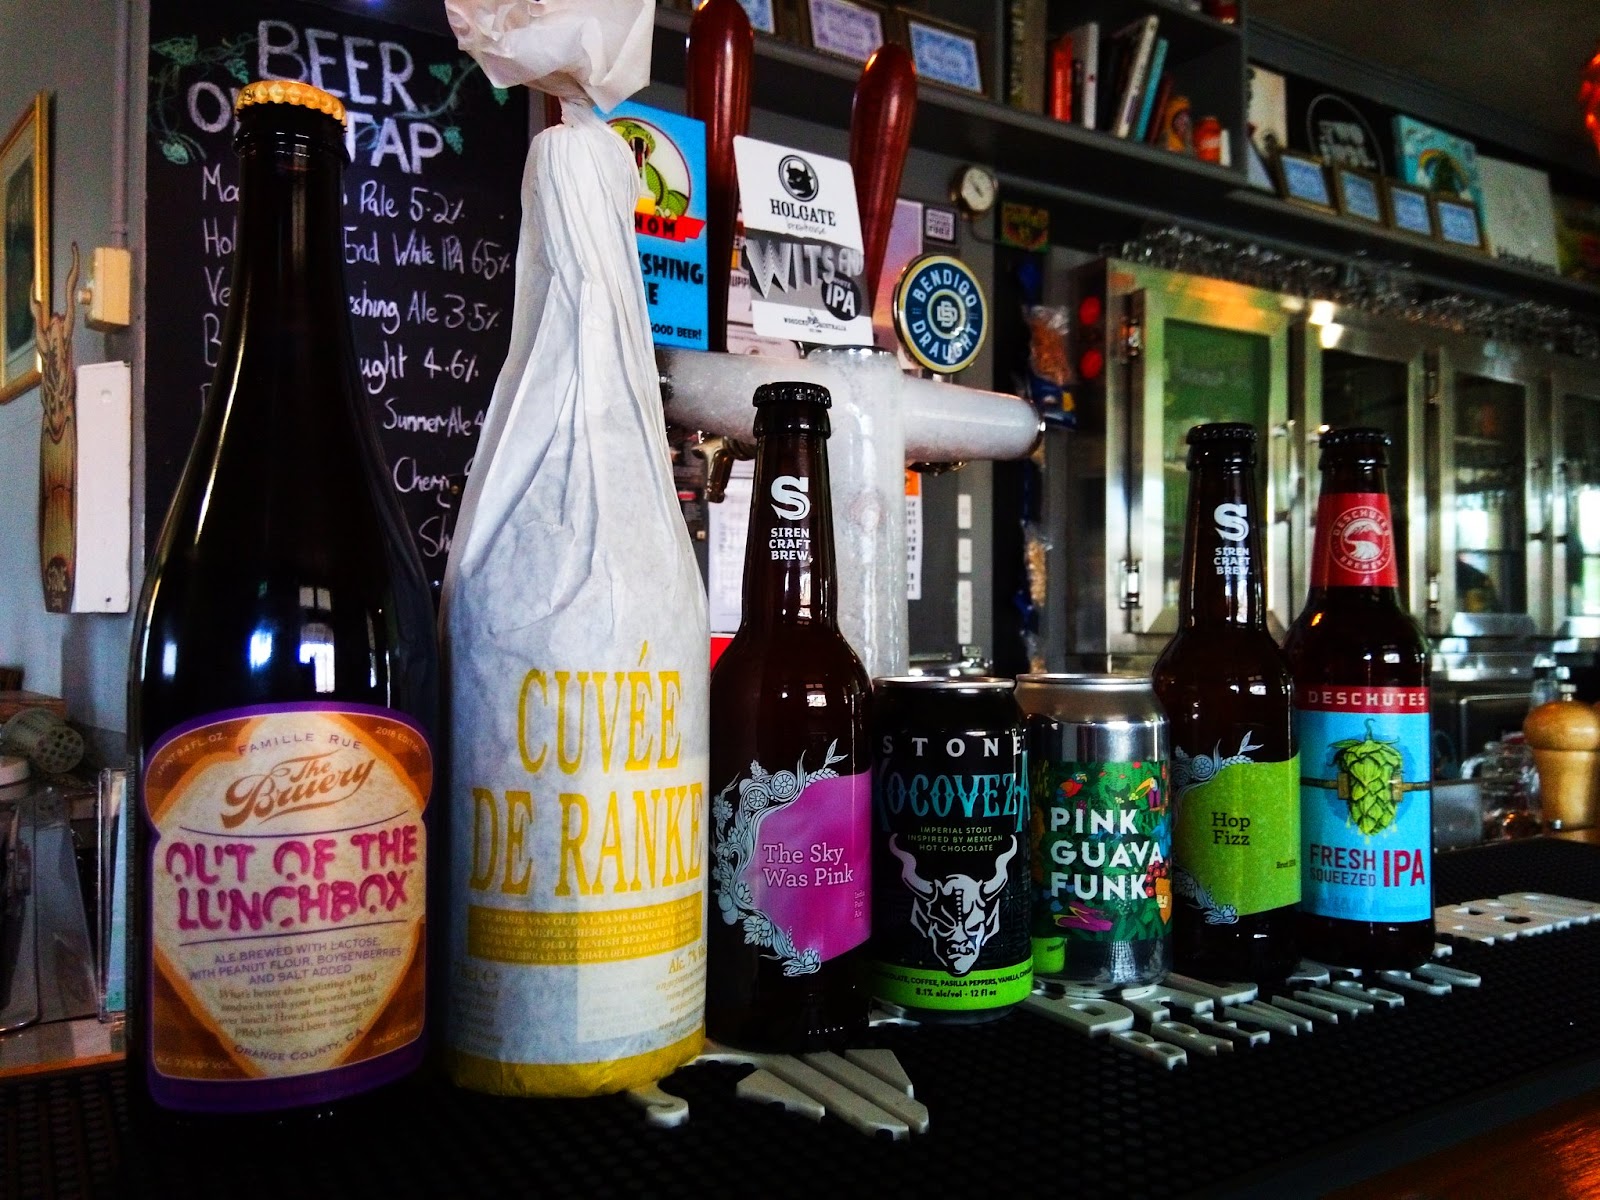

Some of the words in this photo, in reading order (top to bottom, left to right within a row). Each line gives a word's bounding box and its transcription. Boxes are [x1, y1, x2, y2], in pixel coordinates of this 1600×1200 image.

[257, 20, 417, 113] BEER
[187, 82, 239, 134] O
[345, 110, 443, 174] TAP
[360, 180, 399, 219] Pale
[769, 197, 836, 227] HOLGATE
[441, 235, 464, 275] IPA
[639, 251, 704, 285] SHING
[826, 284, 855, 317] IPA
[912, 269, 977, 308] BENDIGO
[349, 281, 401, 335] shing
[407, 290, 438, 324] Ale
[677, 327, 702, 340] BEER!
[912, 319, 978, 363] DRAUGHT
[360, 341, 408, 395] ught
[768, 538, 812, 550] CRAFT
[770, 527, 810, 538] SIREN
[1213, 556, 1251, 566] CRAFT
[1215, 547, 1250, 557] SIREN
[517, 640, 682, 775] CUVÉE
[1308, 691, 1426, 707] DESCHUTES
[238, 733, 315, 757] FAMILLE
[329, 734, 363, 750] RUE
[883, 736, 1024, 758] STONE
[290, 754, 331, 783] The
[220, 758, 377, 829] Bruery
[920, 826, 963, 834] IMPERIAL
[966, 826, 992, 834] STOUT
[1050, 807, 1139, 835] PINK
[1211, 812, 1250, 831] Hop
[469, 787, 534, 896] DE
[555, 782, 702, 896] RANKE
[907, 834, 950, 843] INSPIRED
[965, 835, 1003, 843] MEXICAN
[919, 844, 936, 852] HOT
[939, 844, 993, 852] CHOCOLATE
[1213, 830, 1250, 846] Fizz
[165, 842, 255, 885] OUT
[273, 841, 337, 881] OF
[350, 825, 417, 870] THE
[763, 842, 804, 864] The
[809, 842, 845, 869] Sky
[1050, 840, 1163, 867] GUAVA
[1309, 844, 1377, 871] FRESH
[763, 868, 808, 888] Was
[814, 863, 854, 886] Pink
[1309, 868, 1377, 887] SQUEEZED
[1383, 849, 1426, 888] IPA
[1051, 871, 1149, 900] FUNK
[553, 917, 578, 926] OUD
[632, 910, 655, 920] BIER
[214, 953, 235, 965] ALE
[240, 946, 293, 961] BREWED
[296, 942, 328, 953] WITH
[570, 938, 620, 949] FLEMISH
[623, 934, 650, 945] BEER
[218, 961, 267, 976] PEANUT
[317, 947, 402, 965] BOYSENBERRIES
[249, 973, 276, 986] AND
[278, 967, 310, 981] SALT
[312, 964, 352, 978] ADDED
[911, 977, 939, 987] COFFEE,
[969, 978, 997, 987] PEPPERS,
[970, 989, 978, 997] 12
